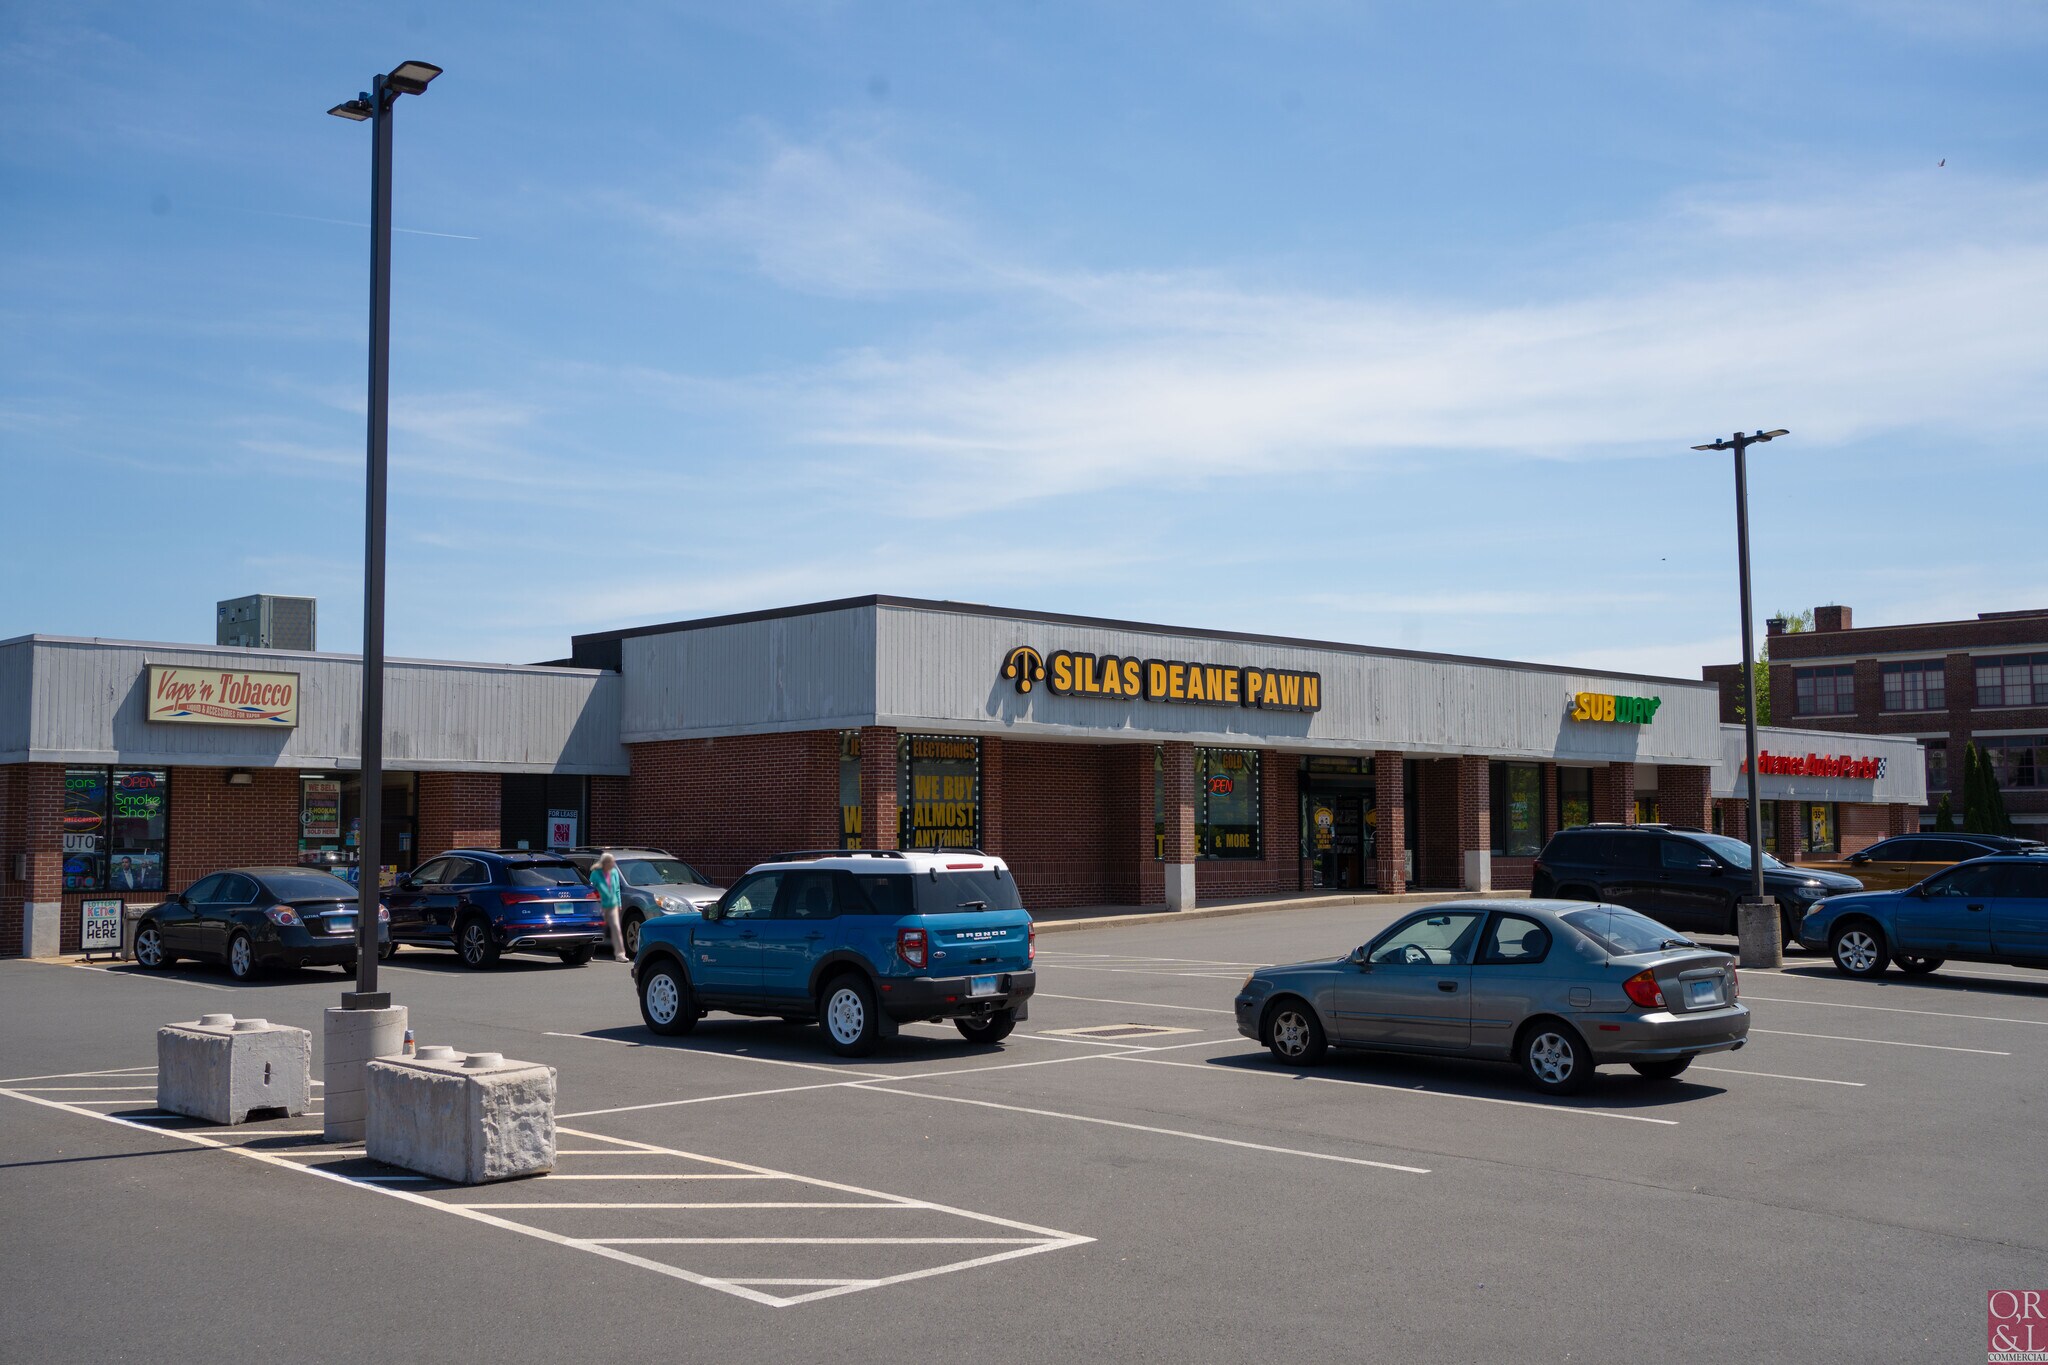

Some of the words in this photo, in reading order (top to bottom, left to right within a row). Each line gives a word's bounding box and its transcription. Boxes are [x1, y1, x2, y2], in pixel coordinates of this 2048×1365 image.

[1054, 655, 1142, 696] SILAS
[1150, 663, 1238, 702] DEANE
[1248, 671, 1318, 707] PAWN
[157, 671, 197, 711] Vape
[218, 673, 292, 707] Tobacco
[206, 707, 236, 718] ACCESSORIES
[1572, 692, 1661, 724] SUBWAY
[913, 742, 976, 758] ELECTRONICS
[1222, 754, 1242, 769] GOLD
[1804, 753, 1840, 777] Auto
[1839, 755, 1878, 779] Parts
[65, 779, 96, 790] gars
[122, 776, 156, 788] OPEN
[914, 775, 939, 800] WE
[943, 776, 974, 800] BUY
[1208, 778, 1233, 792] OPEN
[115, 794, 160, 806] Smoke
[119, 806, 157, 820] Shop
[913, 802, 975, 827] ALMOST
[63, 835, 95, 849] UTO
[915, 829, 973, 848] ANYTHING!
[1215, 836, 1222, 847] &
[1226, 834, 1249, 847] MORE
[87, 906, 117, 917] KENO
[87, 919, 117, 929] PLAY
[87, 929, 117, 939] HERE
[956, 930, 1007, 939] BRONCO
